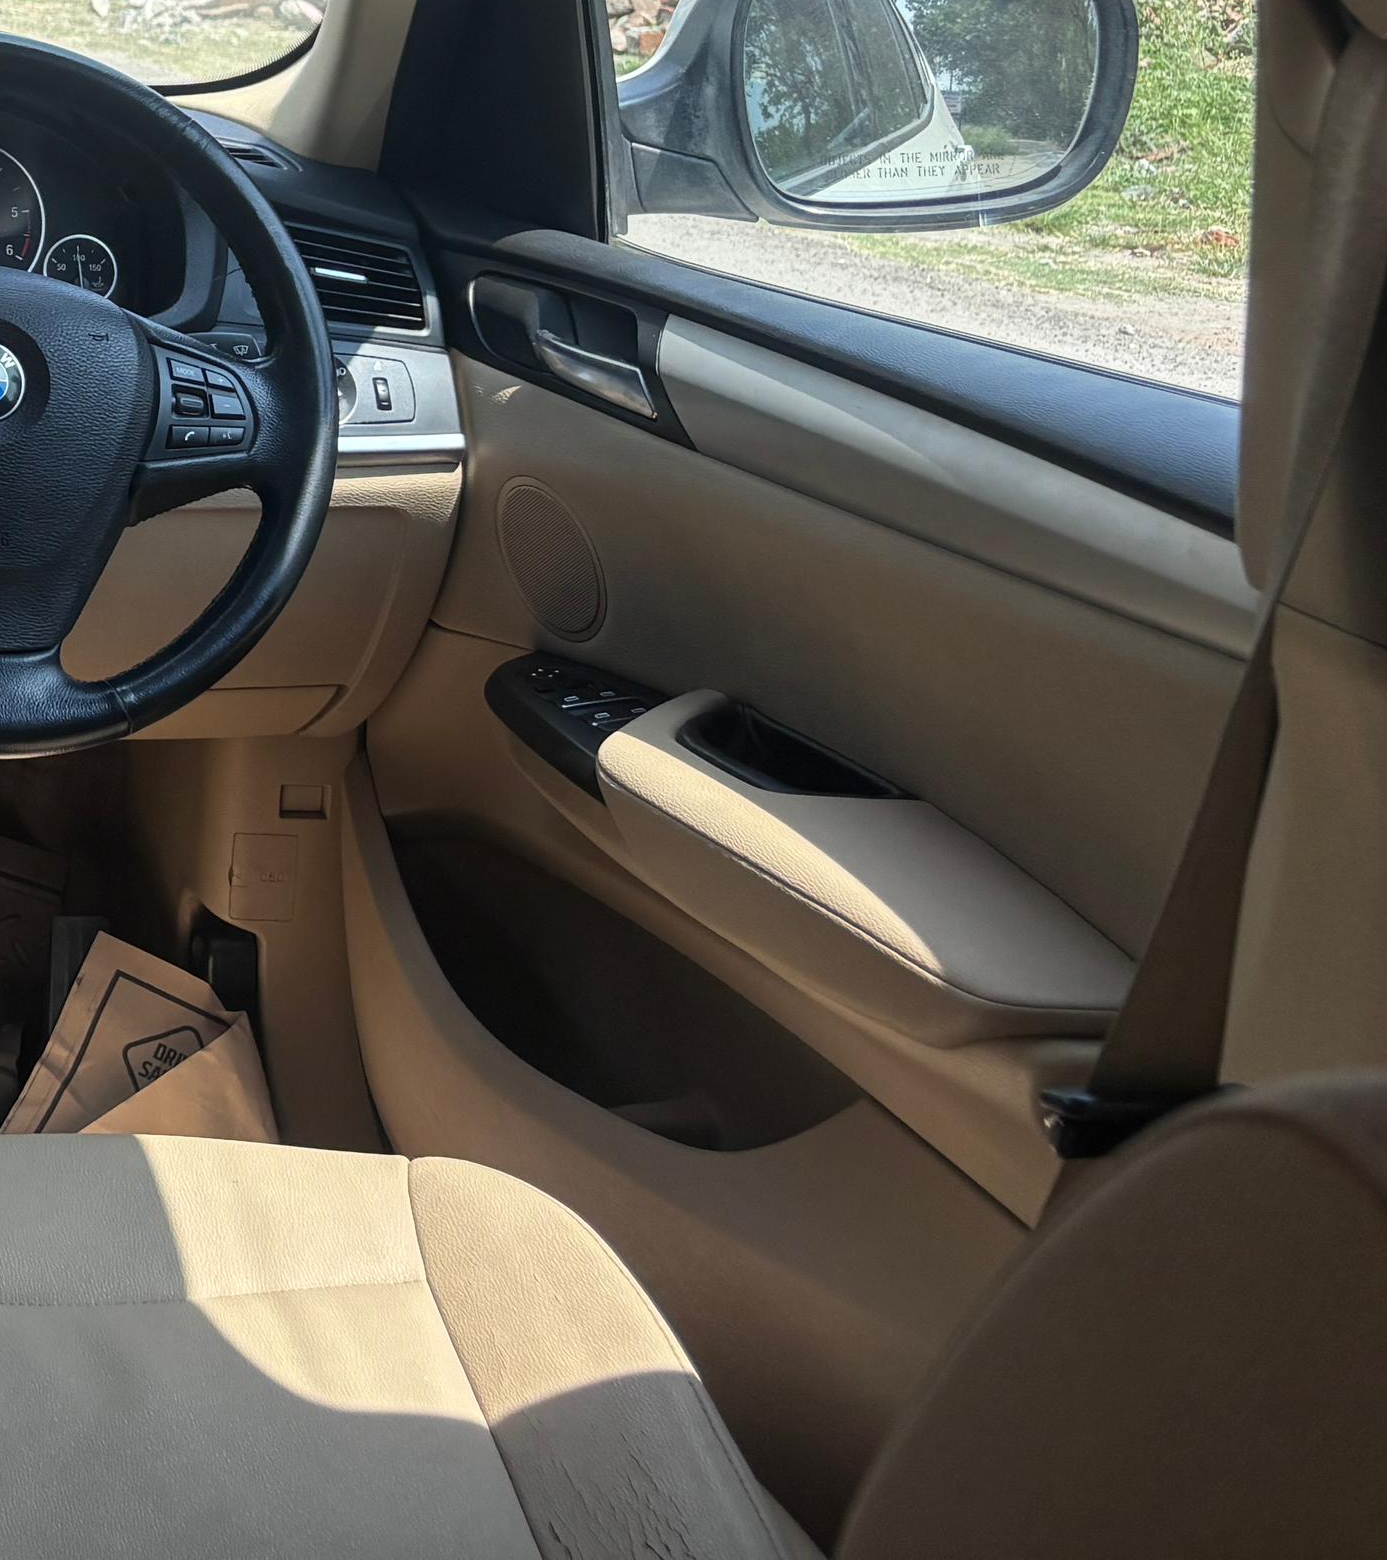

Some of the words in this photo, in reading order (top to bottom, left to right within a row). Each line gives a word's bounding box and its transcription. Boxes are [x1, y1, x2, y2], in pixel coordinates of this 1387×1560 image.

[880, 153, 891, 165] IN
[900, 152, 922, 164] THE
[878, 167, 908, 178] THAN
[917, 165, 945, 177] THEY
[954, 163, 1000, 175] APPEAR
[11, 207, 18, 218] 5
[5, 244, 14, 256] 6
[56, 263, 67, 271] 50
[89, 264, 102, 272] 150
